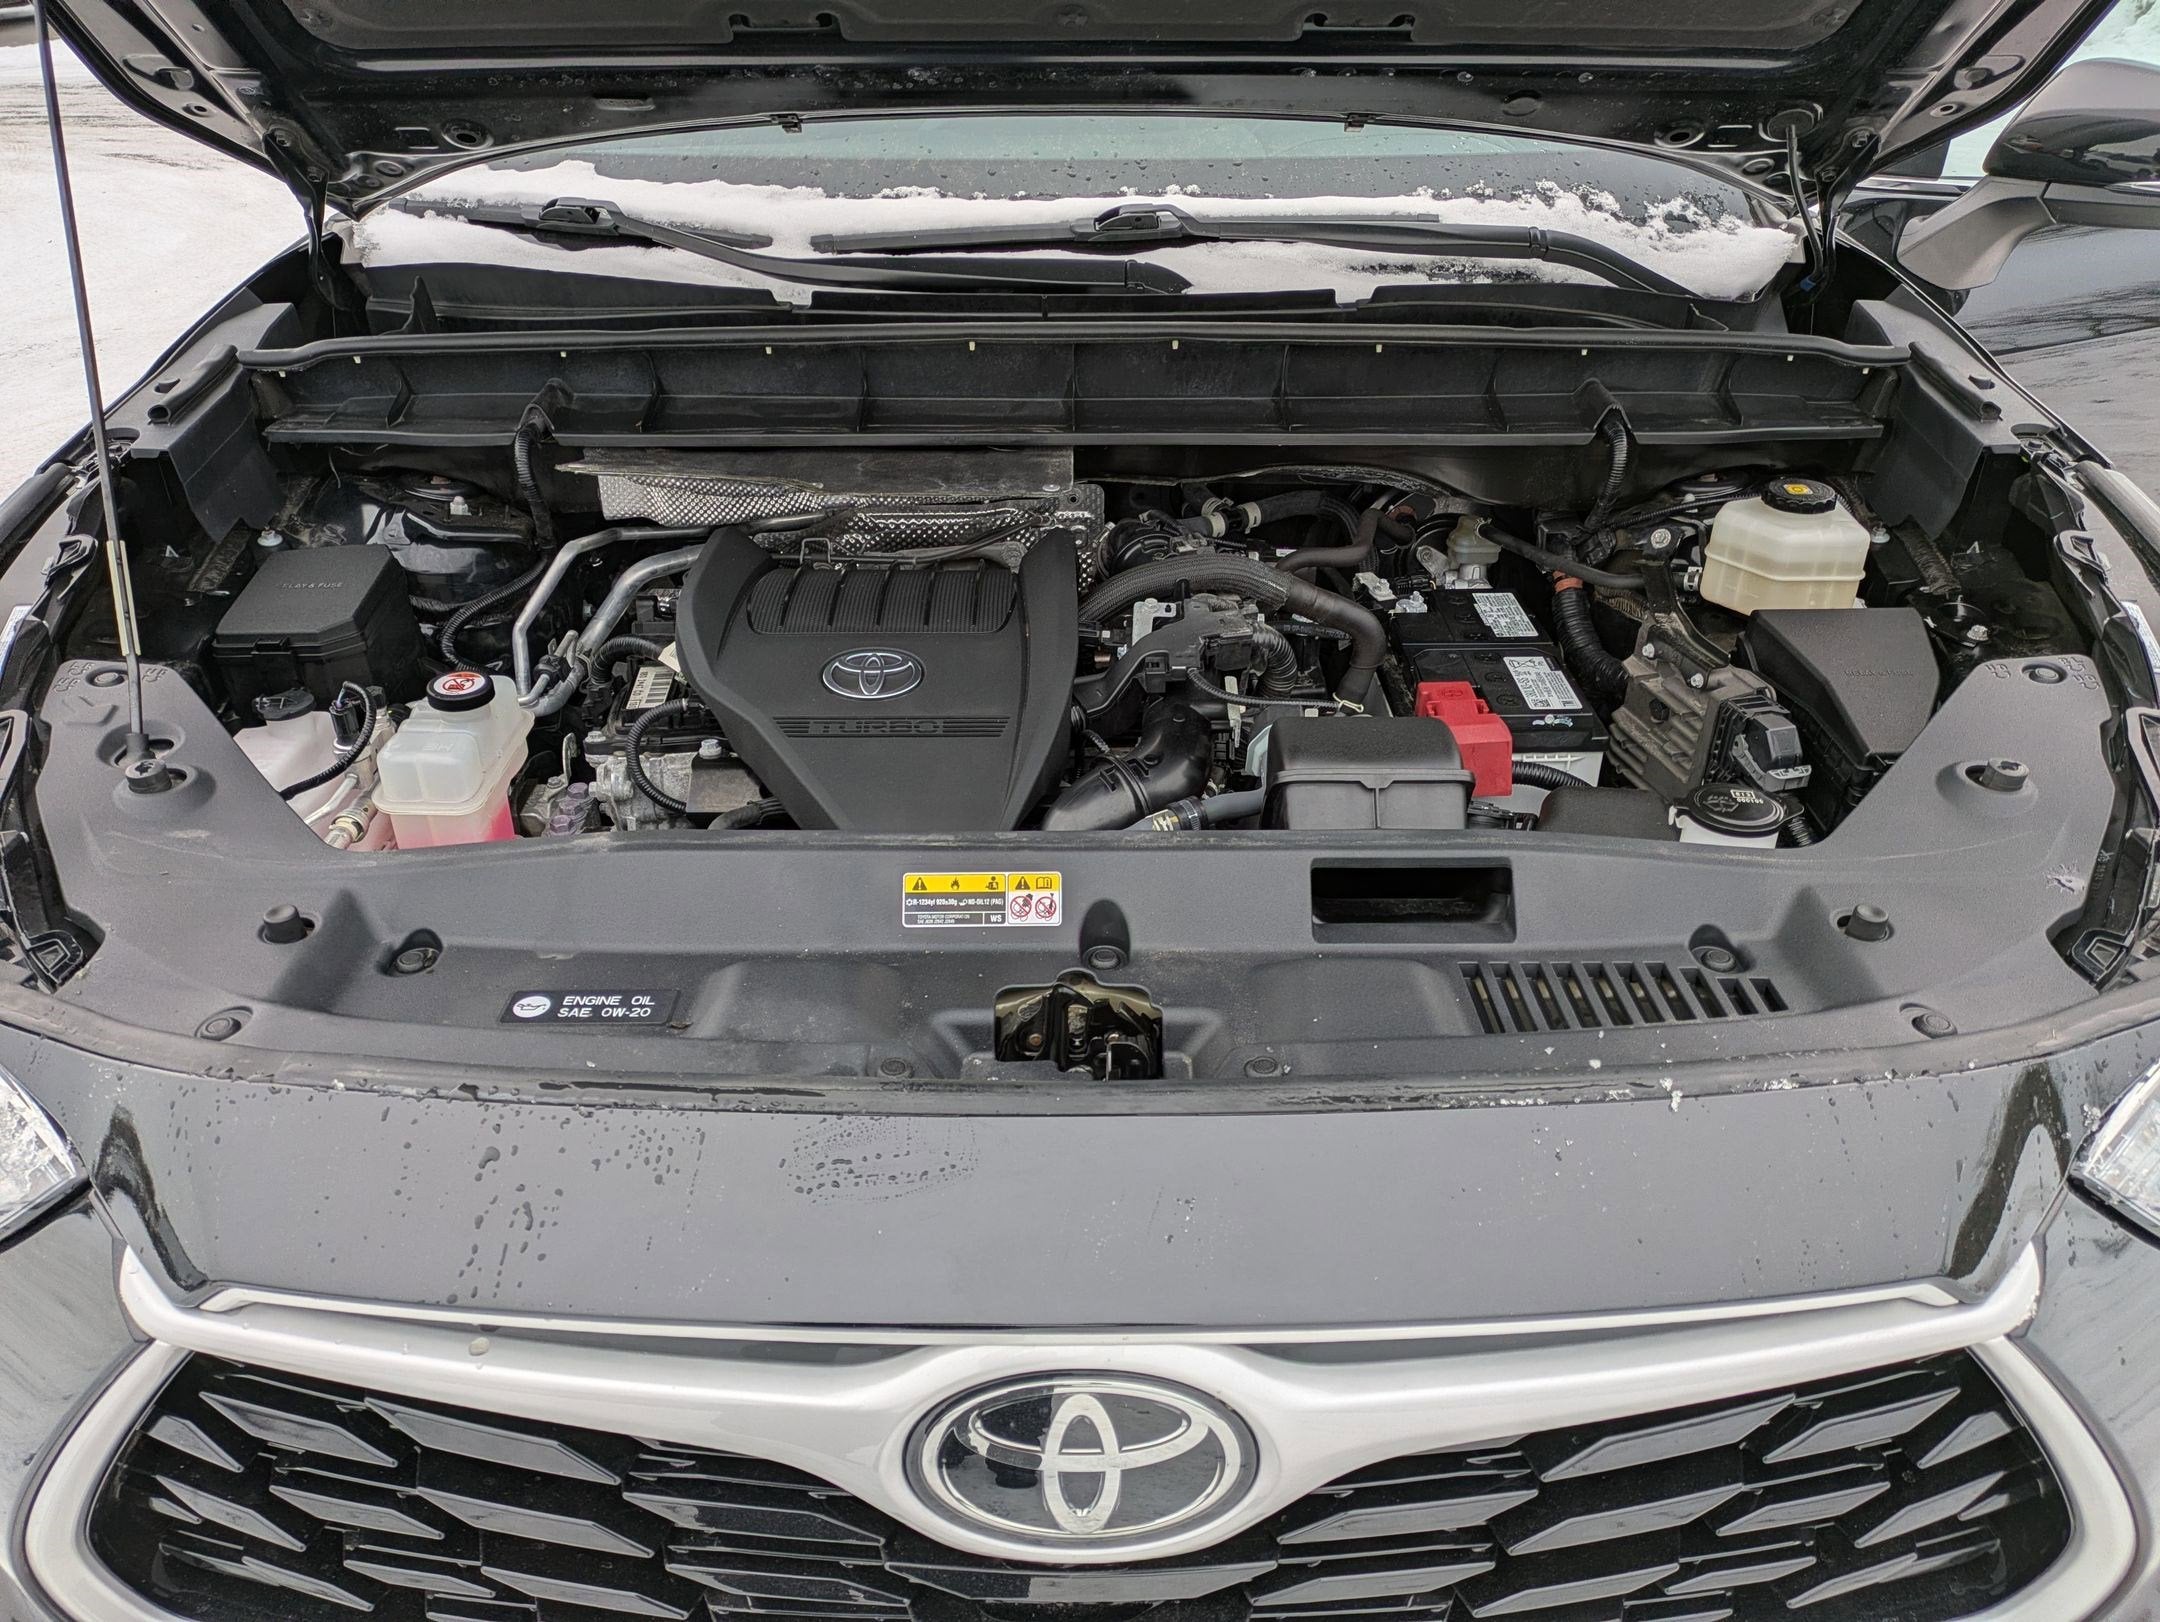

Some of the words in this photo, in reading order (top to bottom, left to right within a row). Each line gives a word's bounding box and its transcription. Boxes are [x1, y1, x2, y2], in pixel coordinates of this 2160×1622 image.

[812, 720, 940, 734] TURBO
[562, 995, 622, 1006] ENGINE
[631, 995, 655, 1006] OIL
[557, 1007, 593, 1018] SAE
[601, 1007, 651, 1018] 0W-20
